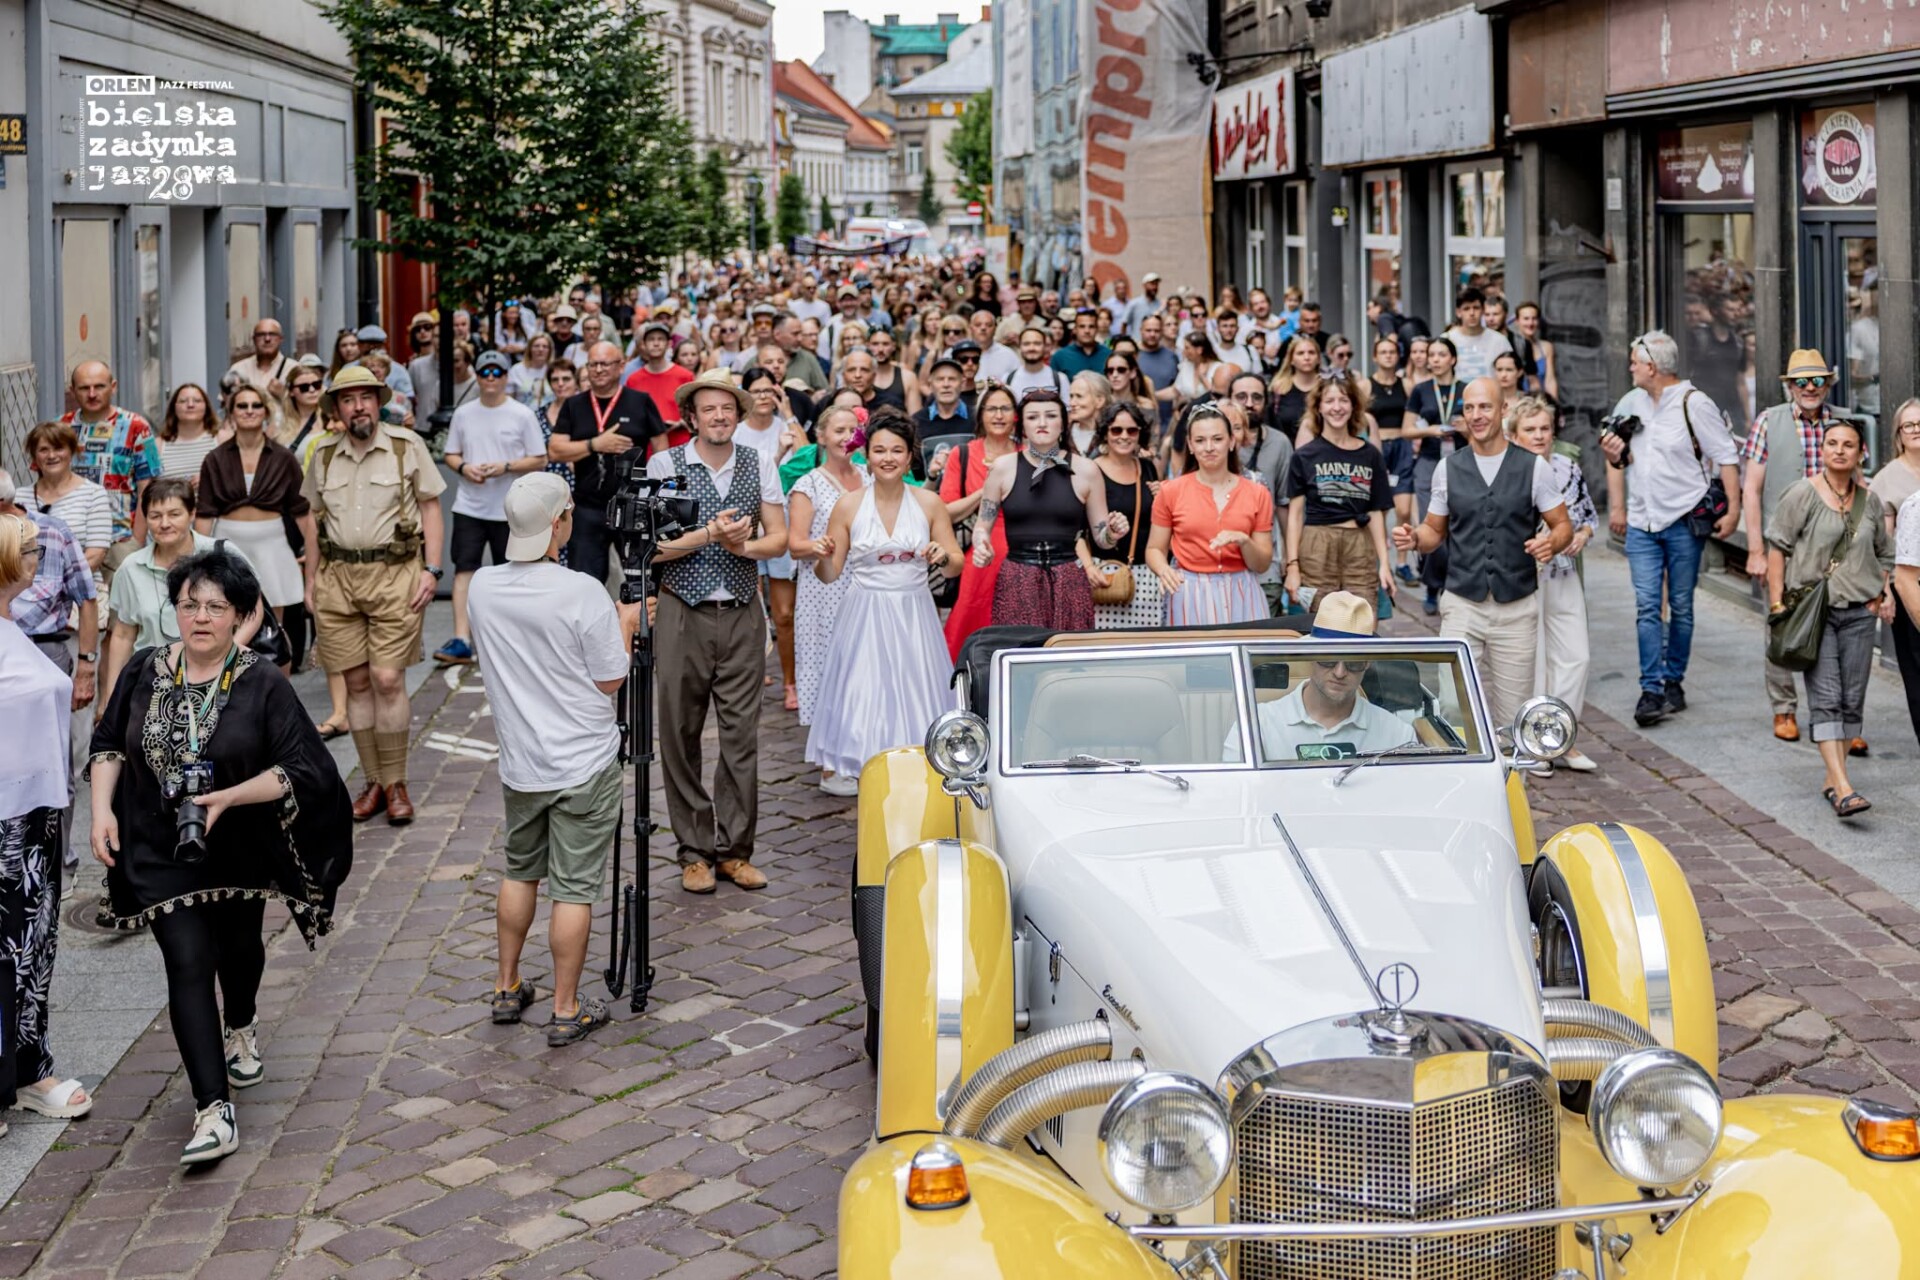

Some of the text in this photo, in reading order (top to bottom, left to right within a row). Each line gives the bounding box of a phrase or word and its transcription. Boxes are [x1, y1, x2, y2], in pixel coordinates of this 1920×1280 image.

[0, 118, 22, 142] 48
[1086, 0, 1153, 300] empr
[1315, 462, 1373, 480] MAINLAND
